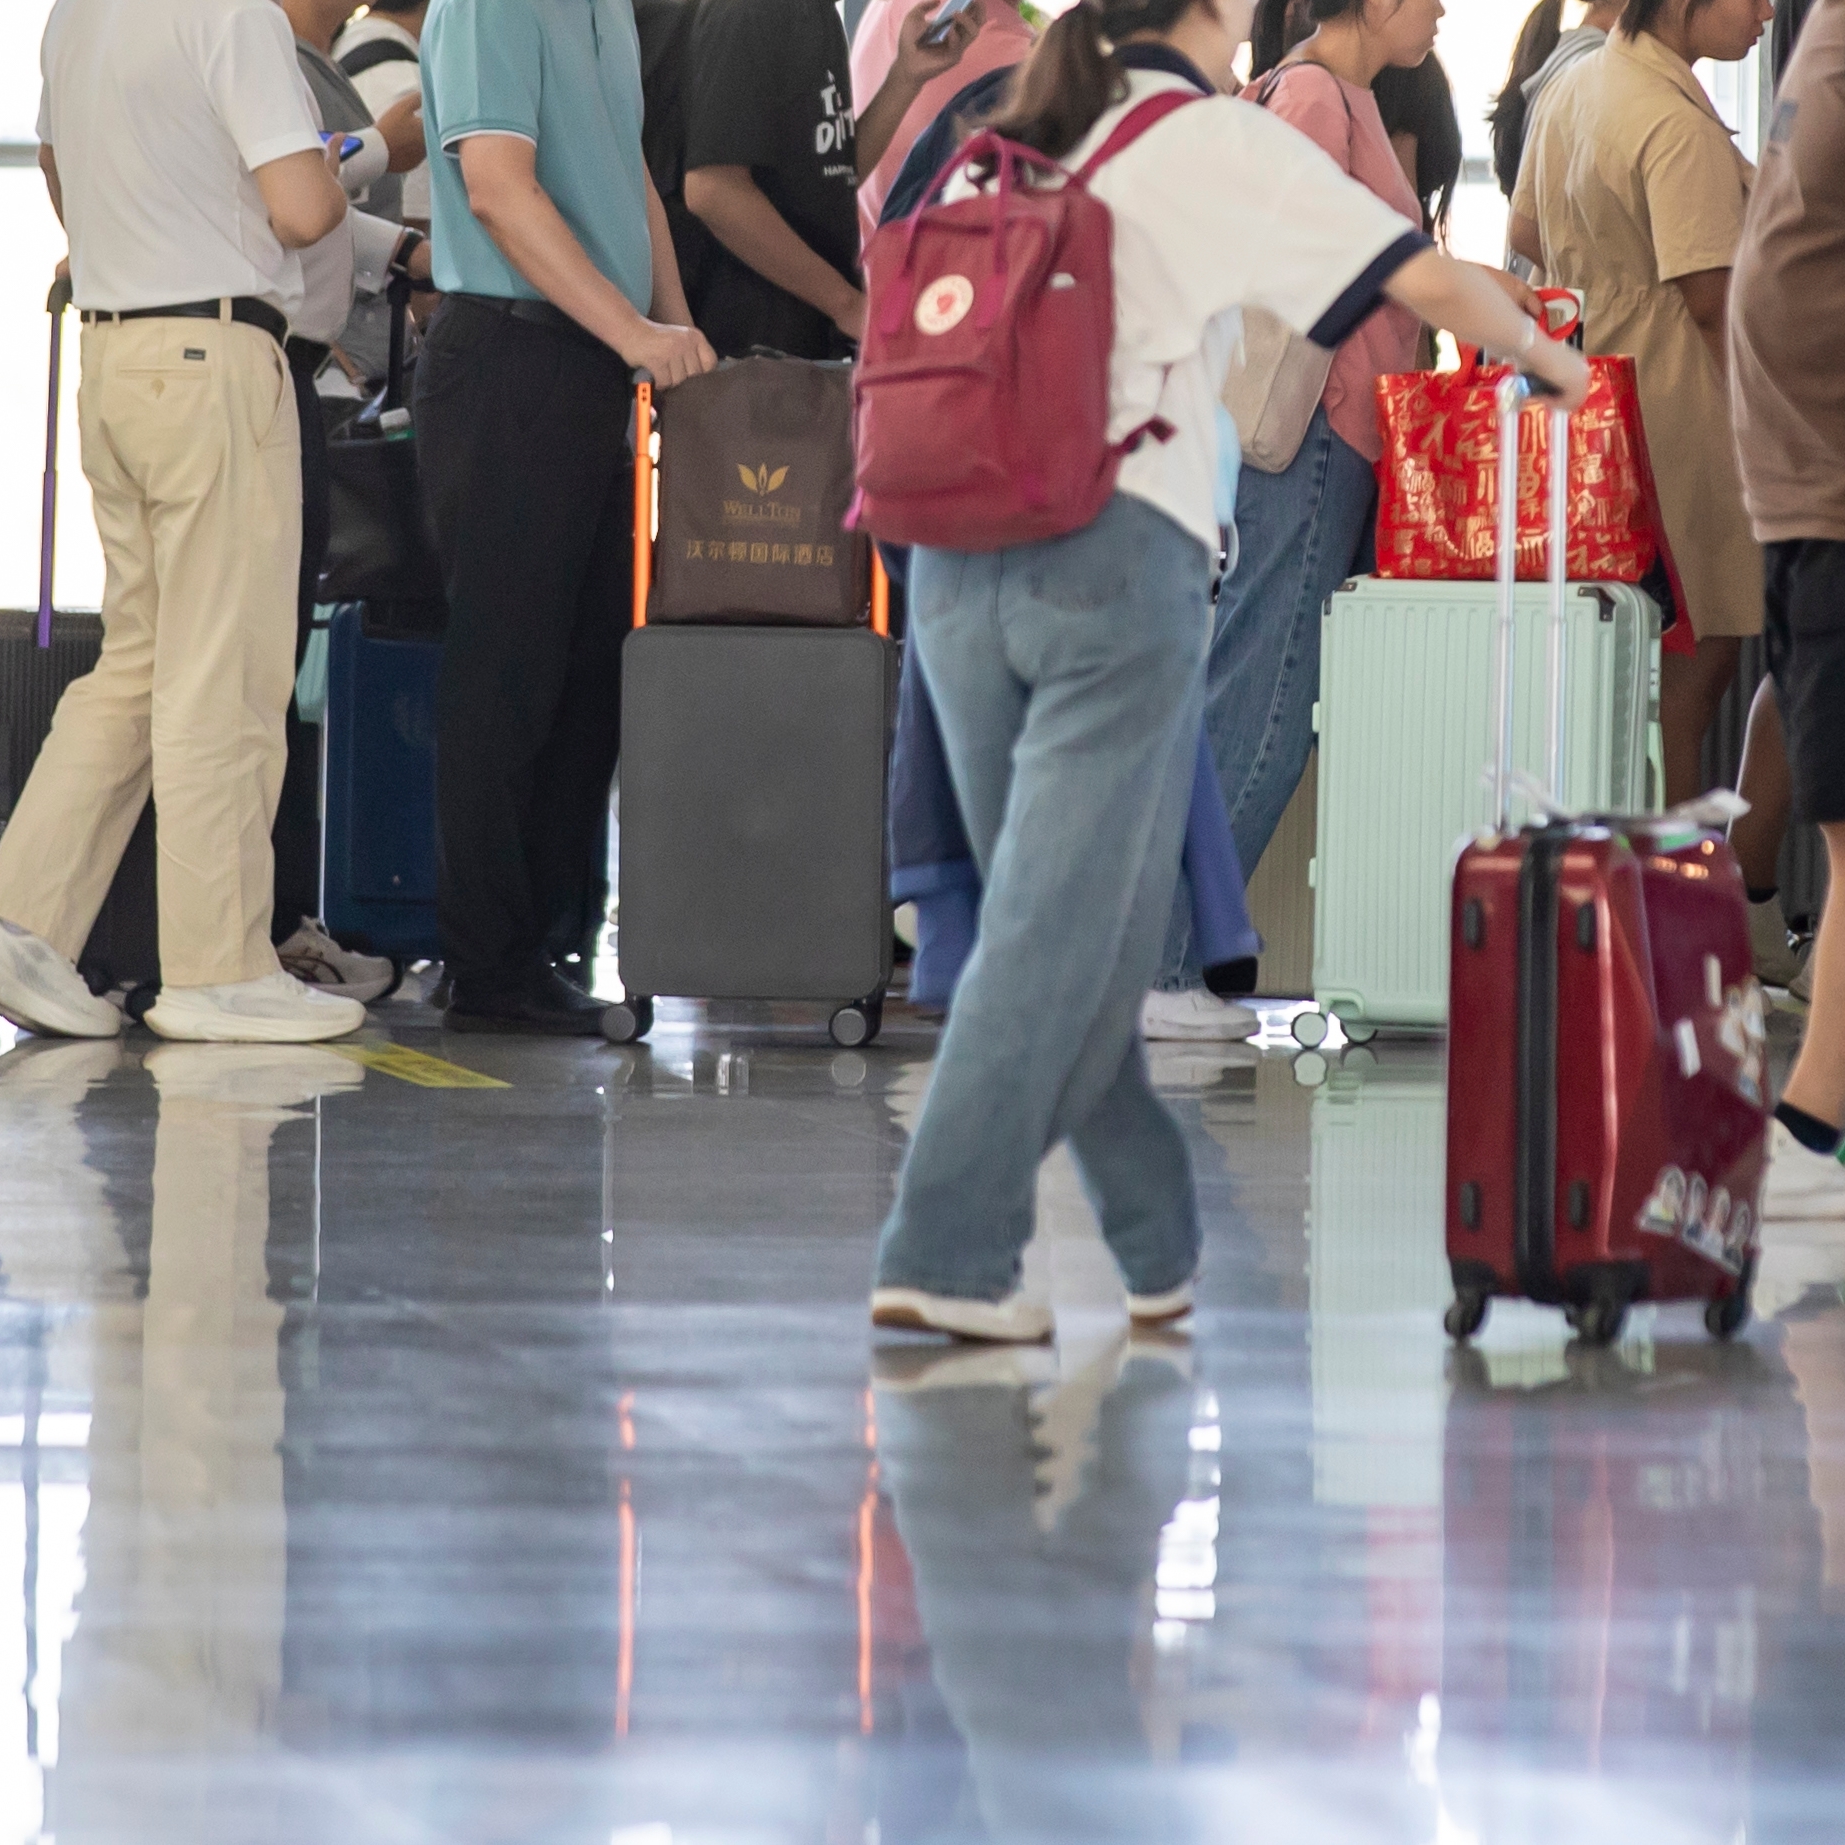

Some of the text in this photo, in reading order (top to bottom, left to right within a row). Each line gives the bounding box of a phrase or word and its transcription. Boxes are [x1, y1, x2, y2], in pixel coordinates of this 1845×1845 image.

[686, 539, 835, 567] 沃尔顿国际酒店
